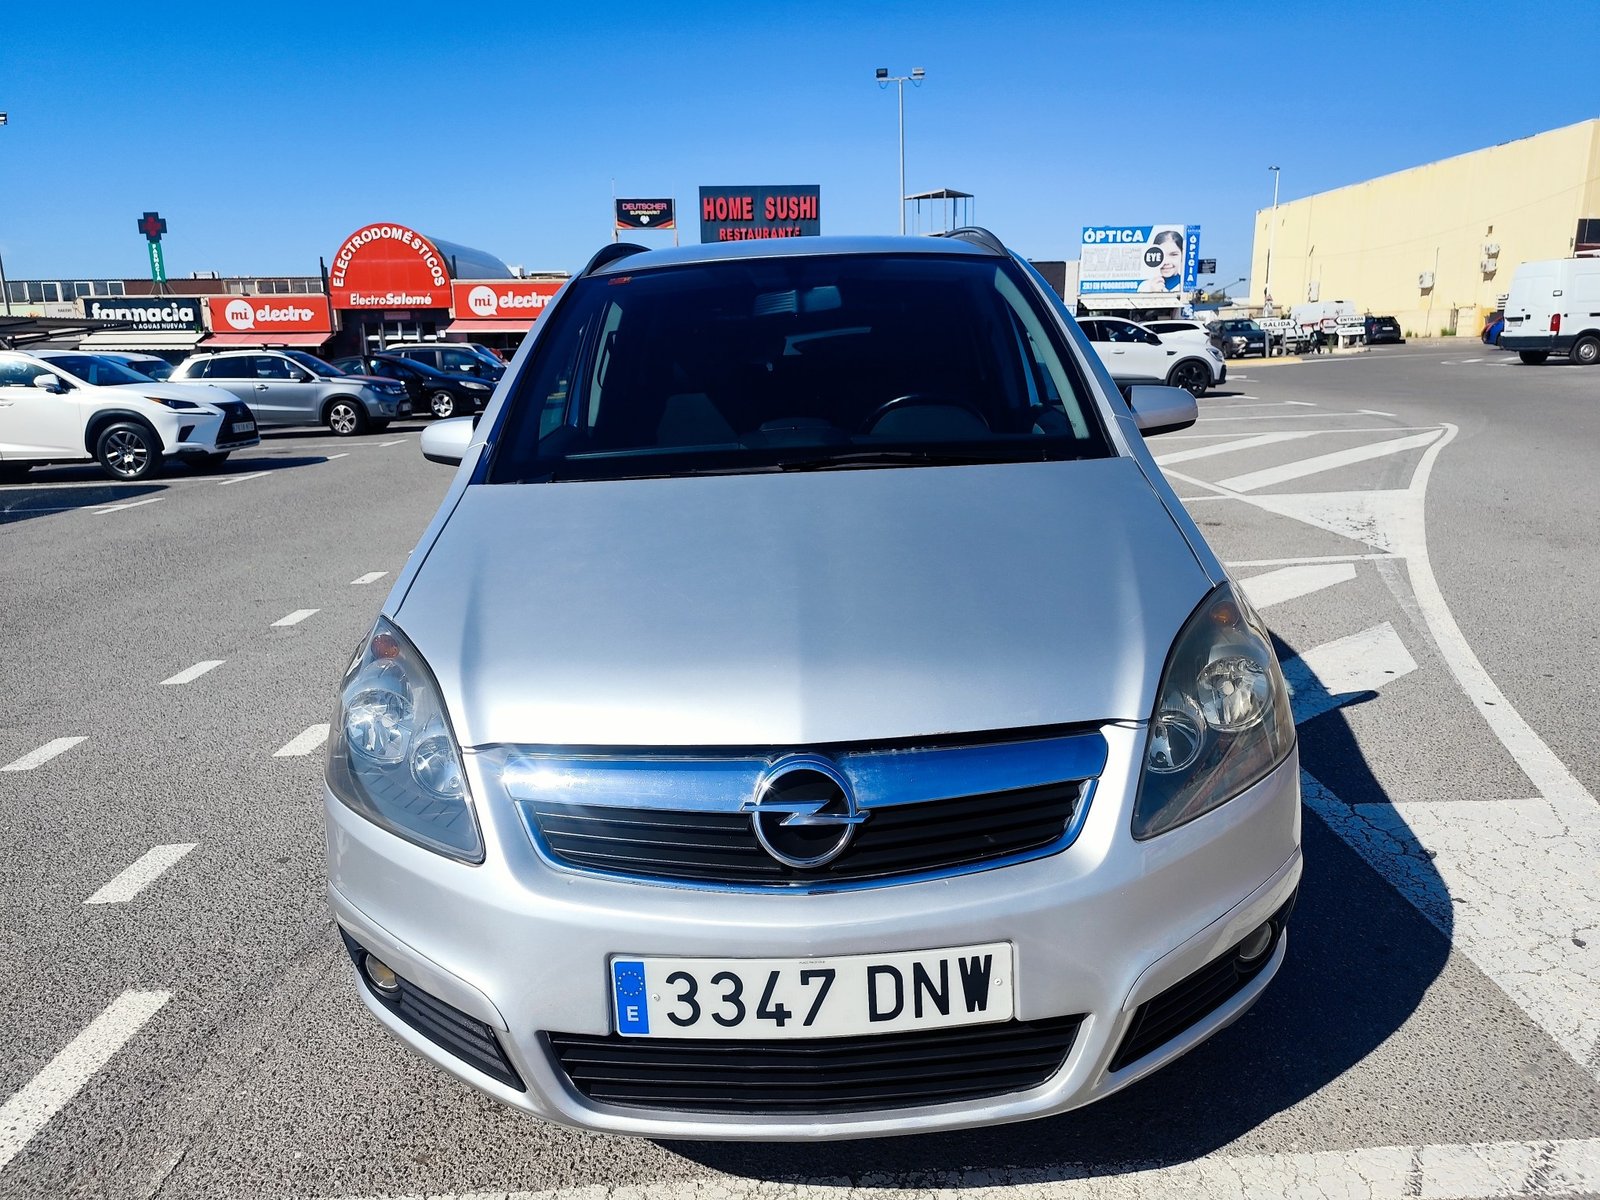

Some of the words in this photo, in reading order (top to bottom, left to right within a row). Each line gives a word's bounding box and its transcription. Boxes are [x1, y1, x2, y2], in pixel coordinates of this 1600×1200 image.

[622, 203, 668, 211] DEUTSCHER
[703, 196, 753, 221] HOME
[765, 196, 817, 221] SUSHI
[1083, 228, 1145, 243] ÓPTICA
[333, 227, 445, 287] ELECTRODOMÉSTICOS
[1146, 253, 1162, 262] EYE
[350, 292, 432, 306] ElectroSalomé
[474, 294, 493, 307] mi
[91, 302, 195, 323] farmacia
[231, 307, 249, 321] mi
[255, 304, 315, 322] electro
[626, 1005, 640, 1022] E
[665, 968, 836, 1027] 3347
[866, 953, 993, 1023] DNW
